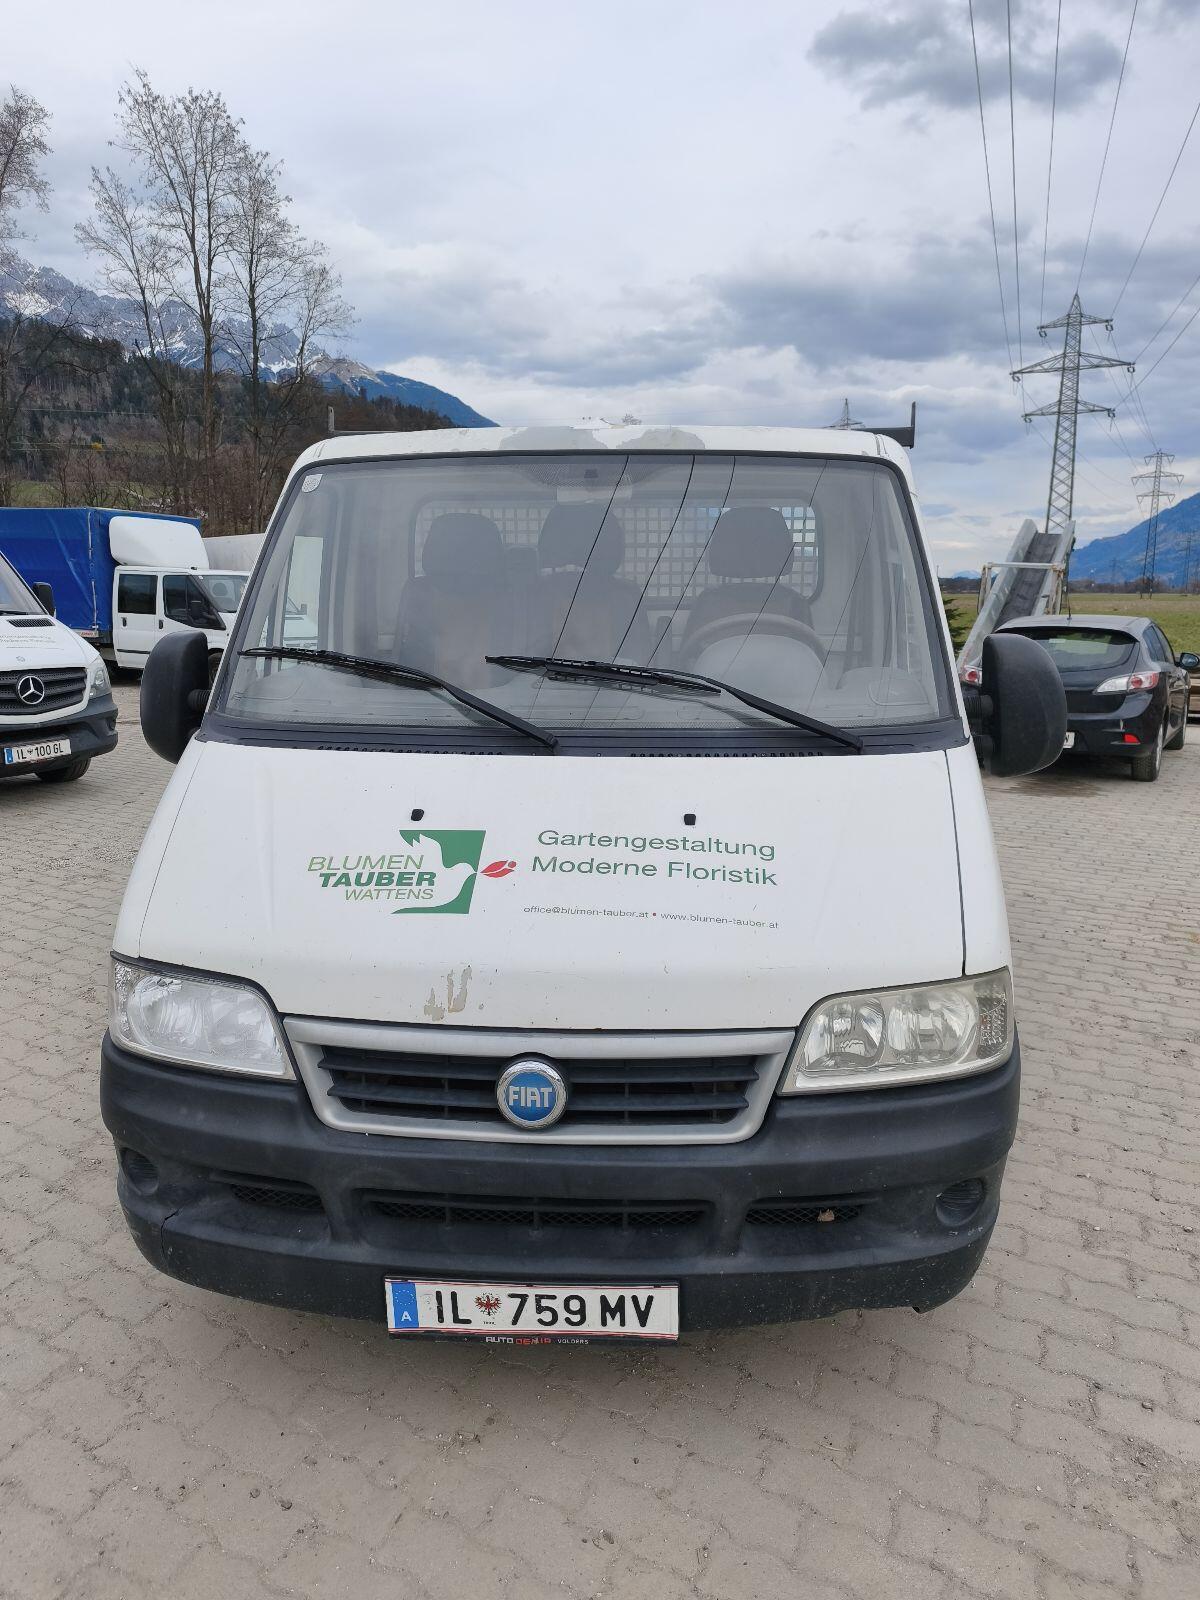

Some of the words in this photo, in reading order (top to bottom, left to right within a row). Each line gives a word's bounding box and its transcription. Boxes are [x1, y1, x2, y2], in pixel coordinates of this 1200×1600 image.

[16, 748, 27, 760] IL
[35, 744, 52, 757] 100
[53, 742, 64, 754] GL
[537, 829, 775, 861] Gartengestaltung
[307, 854, 425, 871] BLUMEN
[532, 856, 658, 877] Moderne
[668, 861, 778, 886] Floristik
[319, 871, 437, 888] TAUBER
[345, 888, 434, 901] WATTENS
[523, 905, 649, 919] office@blumen-tauber.at
[660, 913, 779, 929] www.blumen-tauber.at
[508, 1085, 552, 1108] FIAT
[401, 1310, 412, 1322] A
[435, 1290, 472, 1325] IL
[507, 1292, 586, 1327] 759
[600, 1294, 654, 1328] MV
[485, 1336, 514, 1344] AUTO
